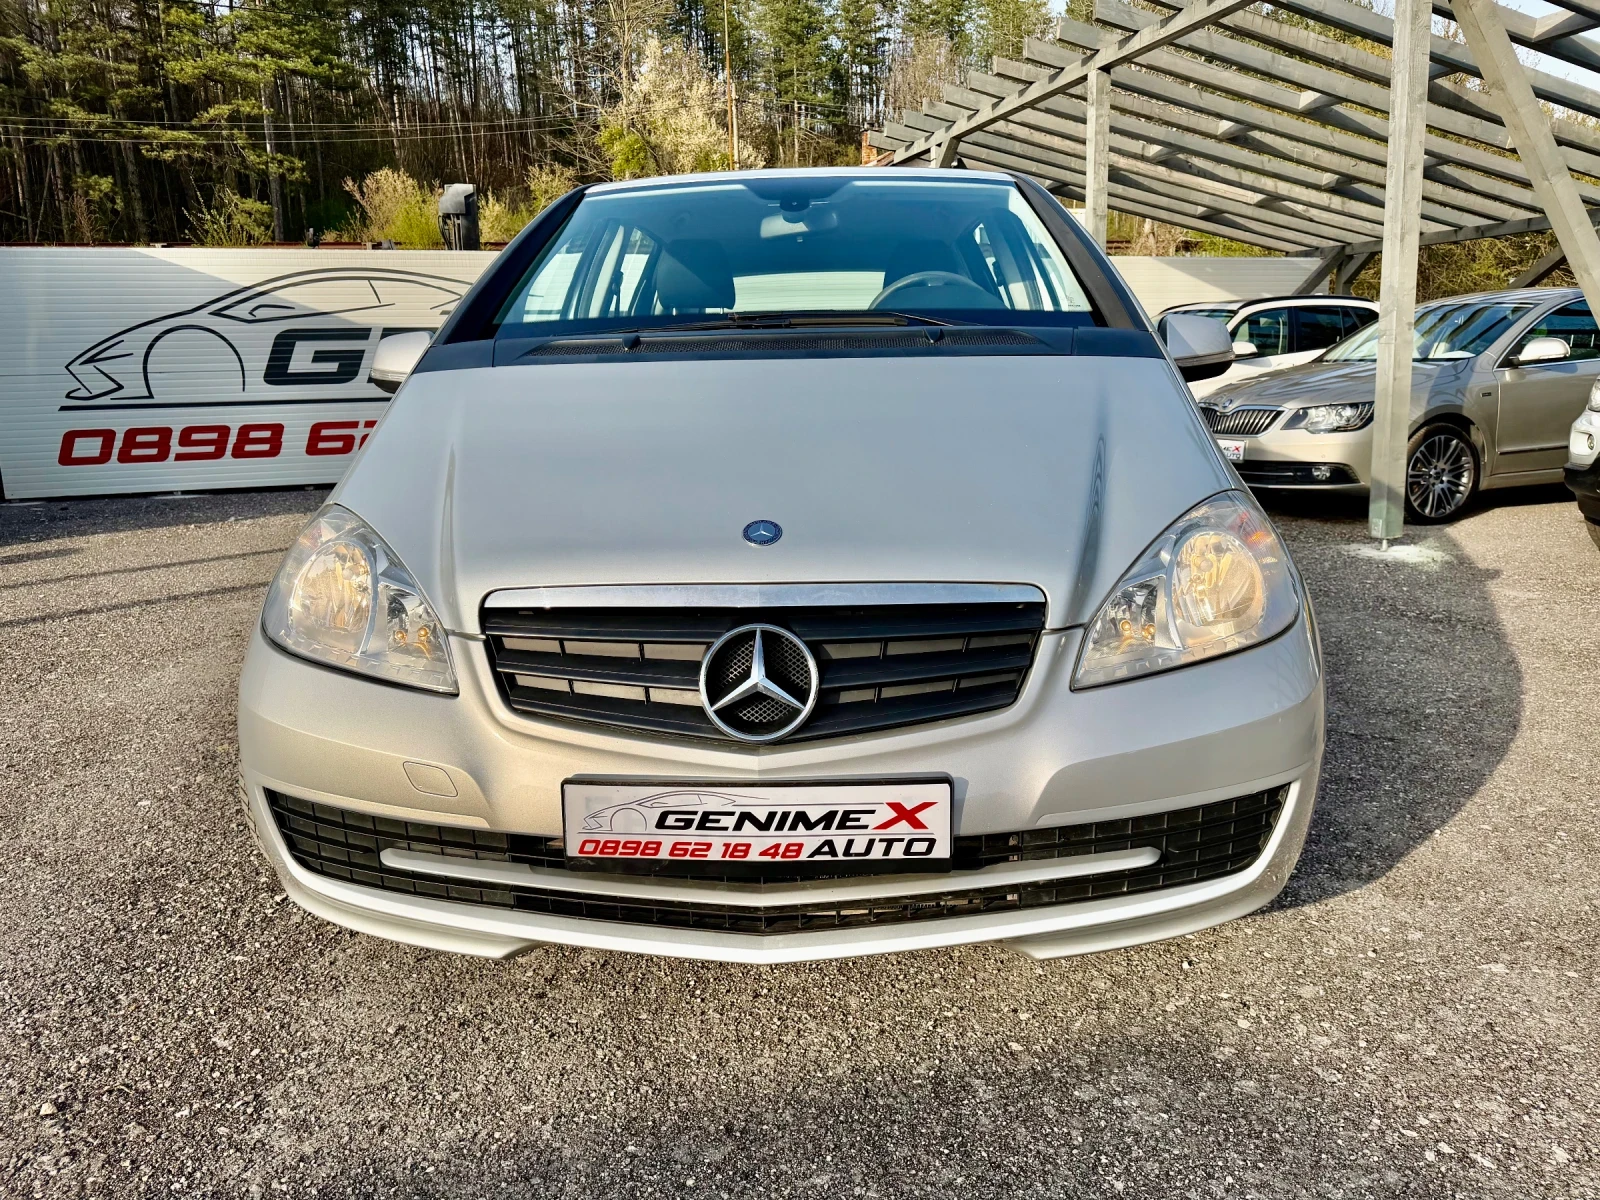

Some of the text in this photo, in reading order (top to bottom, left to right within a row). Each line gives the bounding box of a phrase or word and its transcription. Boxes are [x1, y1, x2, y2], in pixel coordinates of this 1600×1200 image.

[58, 423, 284, 466] 0898
[655, 801, 938, 832] GENIMEX
[577, 837, 937, 860] 0898 62 18 48 AUTO
